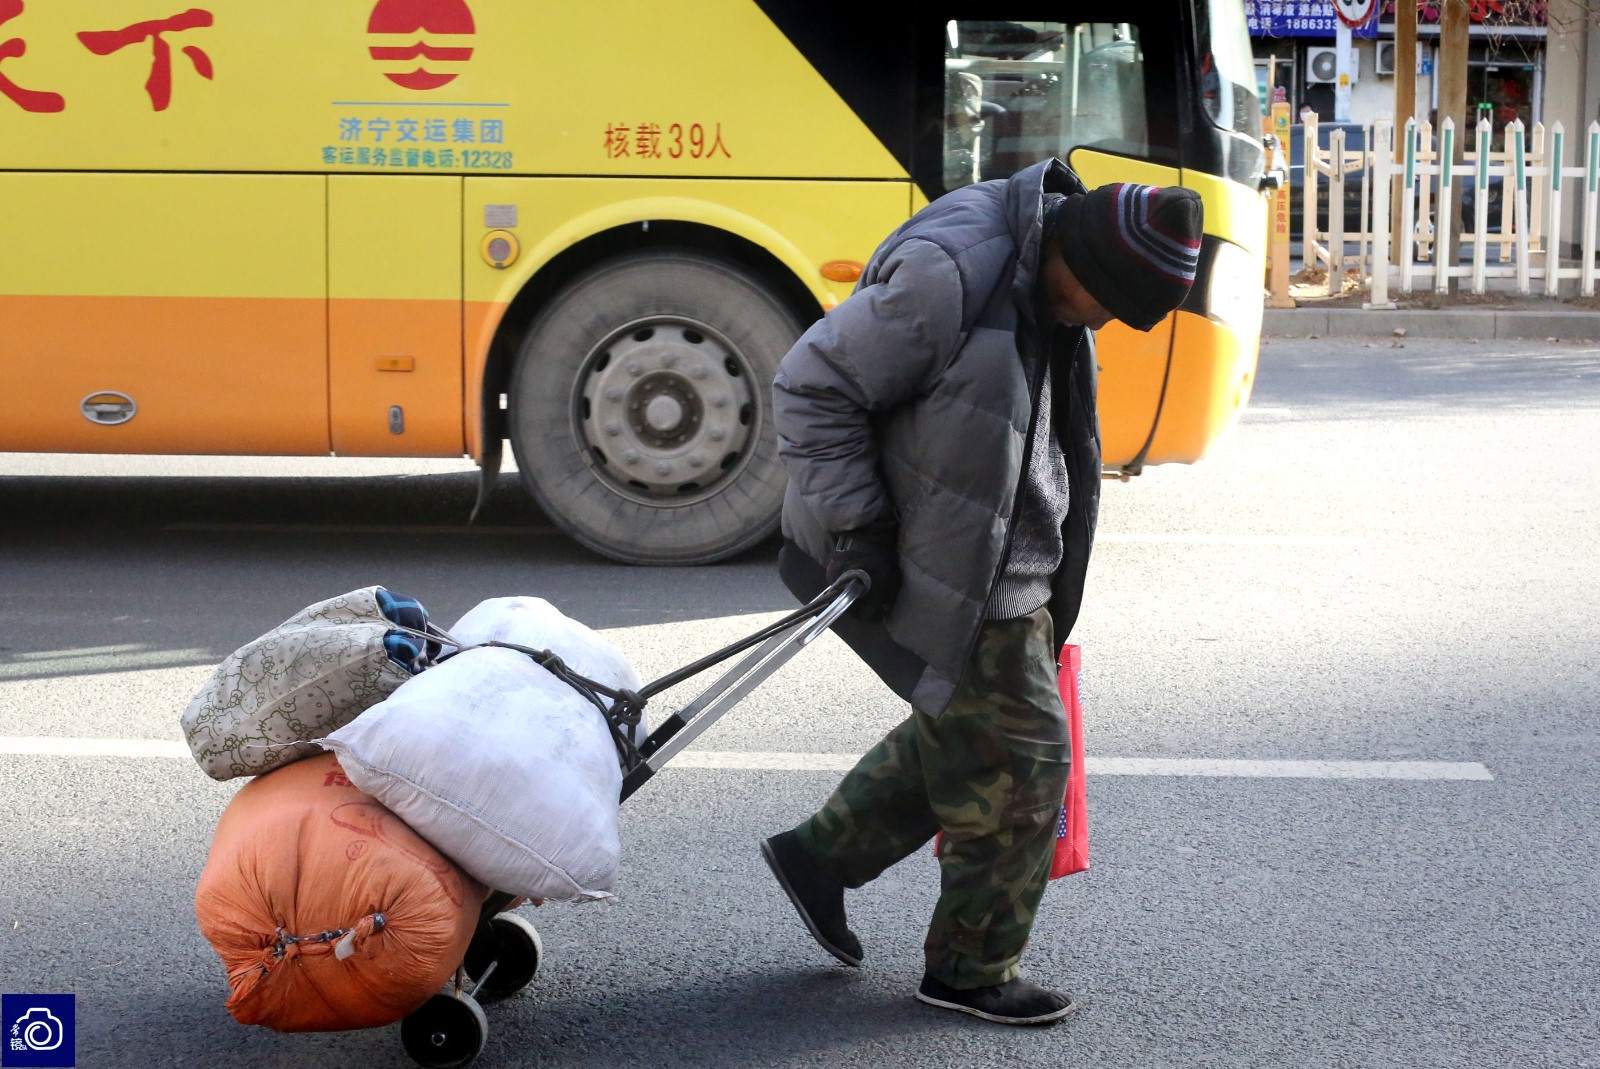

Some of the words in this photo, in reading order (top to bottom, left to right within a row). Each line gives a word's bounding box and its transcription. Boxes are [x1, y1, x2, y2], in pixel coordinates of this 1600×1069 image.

[1286, 18, 1370, 30] 18863337
[338, 117, 503, 144] 济宁交运集团
[604, 122, 731, 159] 核载39人
[322, 146, 513, 169] 客运服务监督电话:12328
